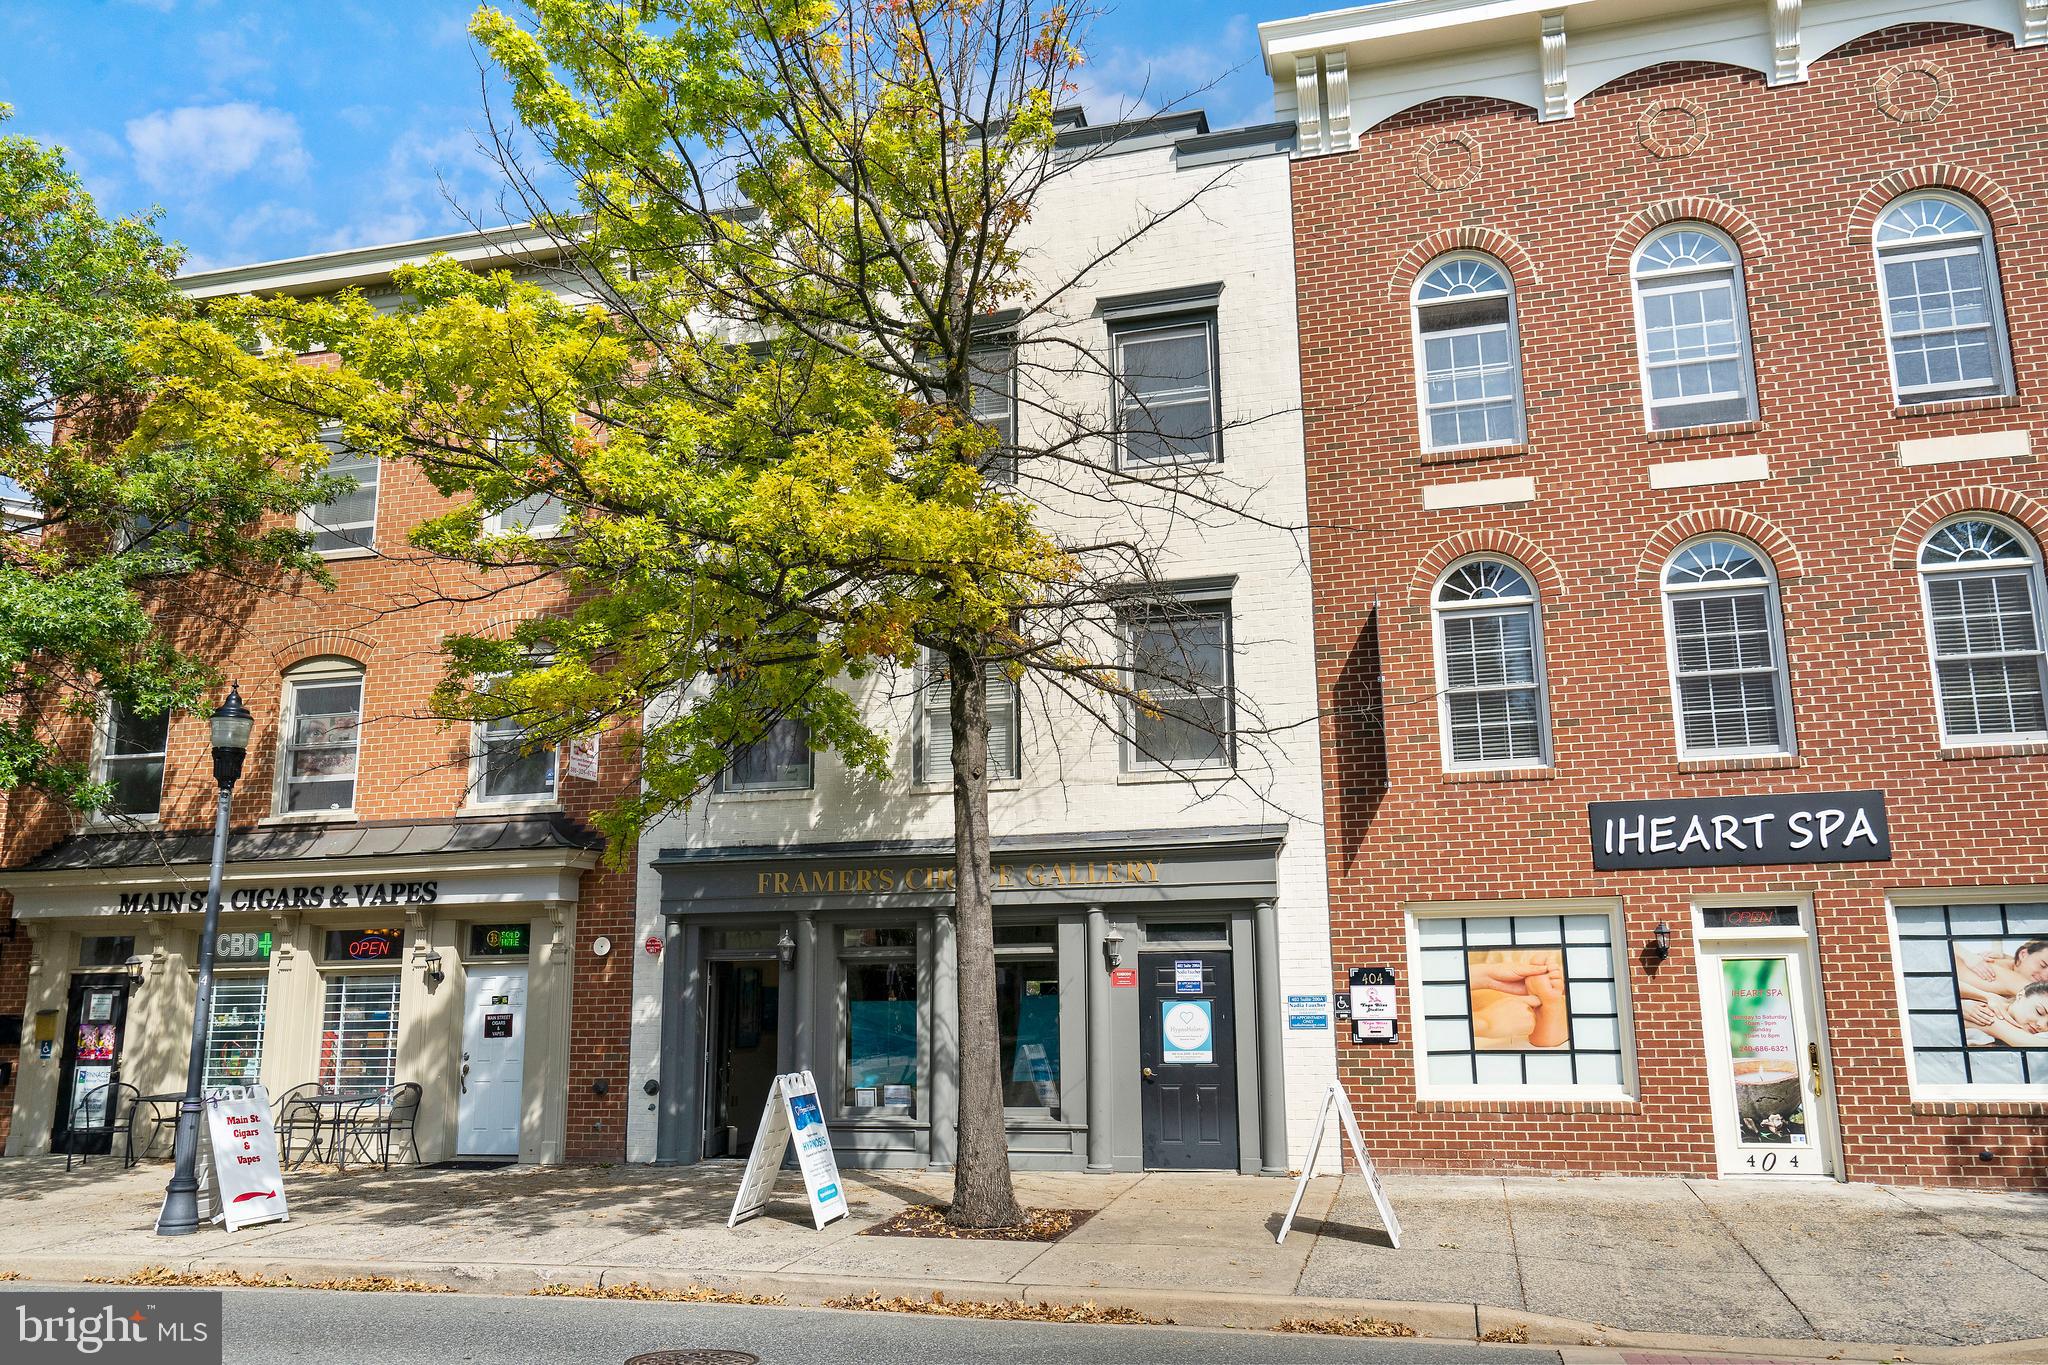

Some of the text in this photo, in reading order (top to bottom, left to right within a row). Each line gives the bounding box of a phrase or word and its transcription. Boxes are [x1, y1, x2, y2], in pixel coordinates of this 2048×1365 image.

[1603, 807, 1879, 855] IHEART SPA
[757, 867, 895, 894] FRAMER'S
[1025, 858, 1164, 887] GALLERY
[118, 891, 187, 914] MAIN
[230, 886, 326, 911] CIGARS
[329, 884, 350, 908] &
[353, 881, 438, 907] VAPES
[1727, 911, 1774, 926] OPEN
[349, 941, 391, 956] OPEN
[1361, 973, 1384, 985] 404
[1731, 988, 1784, 997] IHEART SPA
[226, 1114, 261, 1126] Main St.
[233, 1128, 259, 1139] Cigars
[243, 1141, 250, 1150] &
[237, 1155, 261, 1166] Vapes
